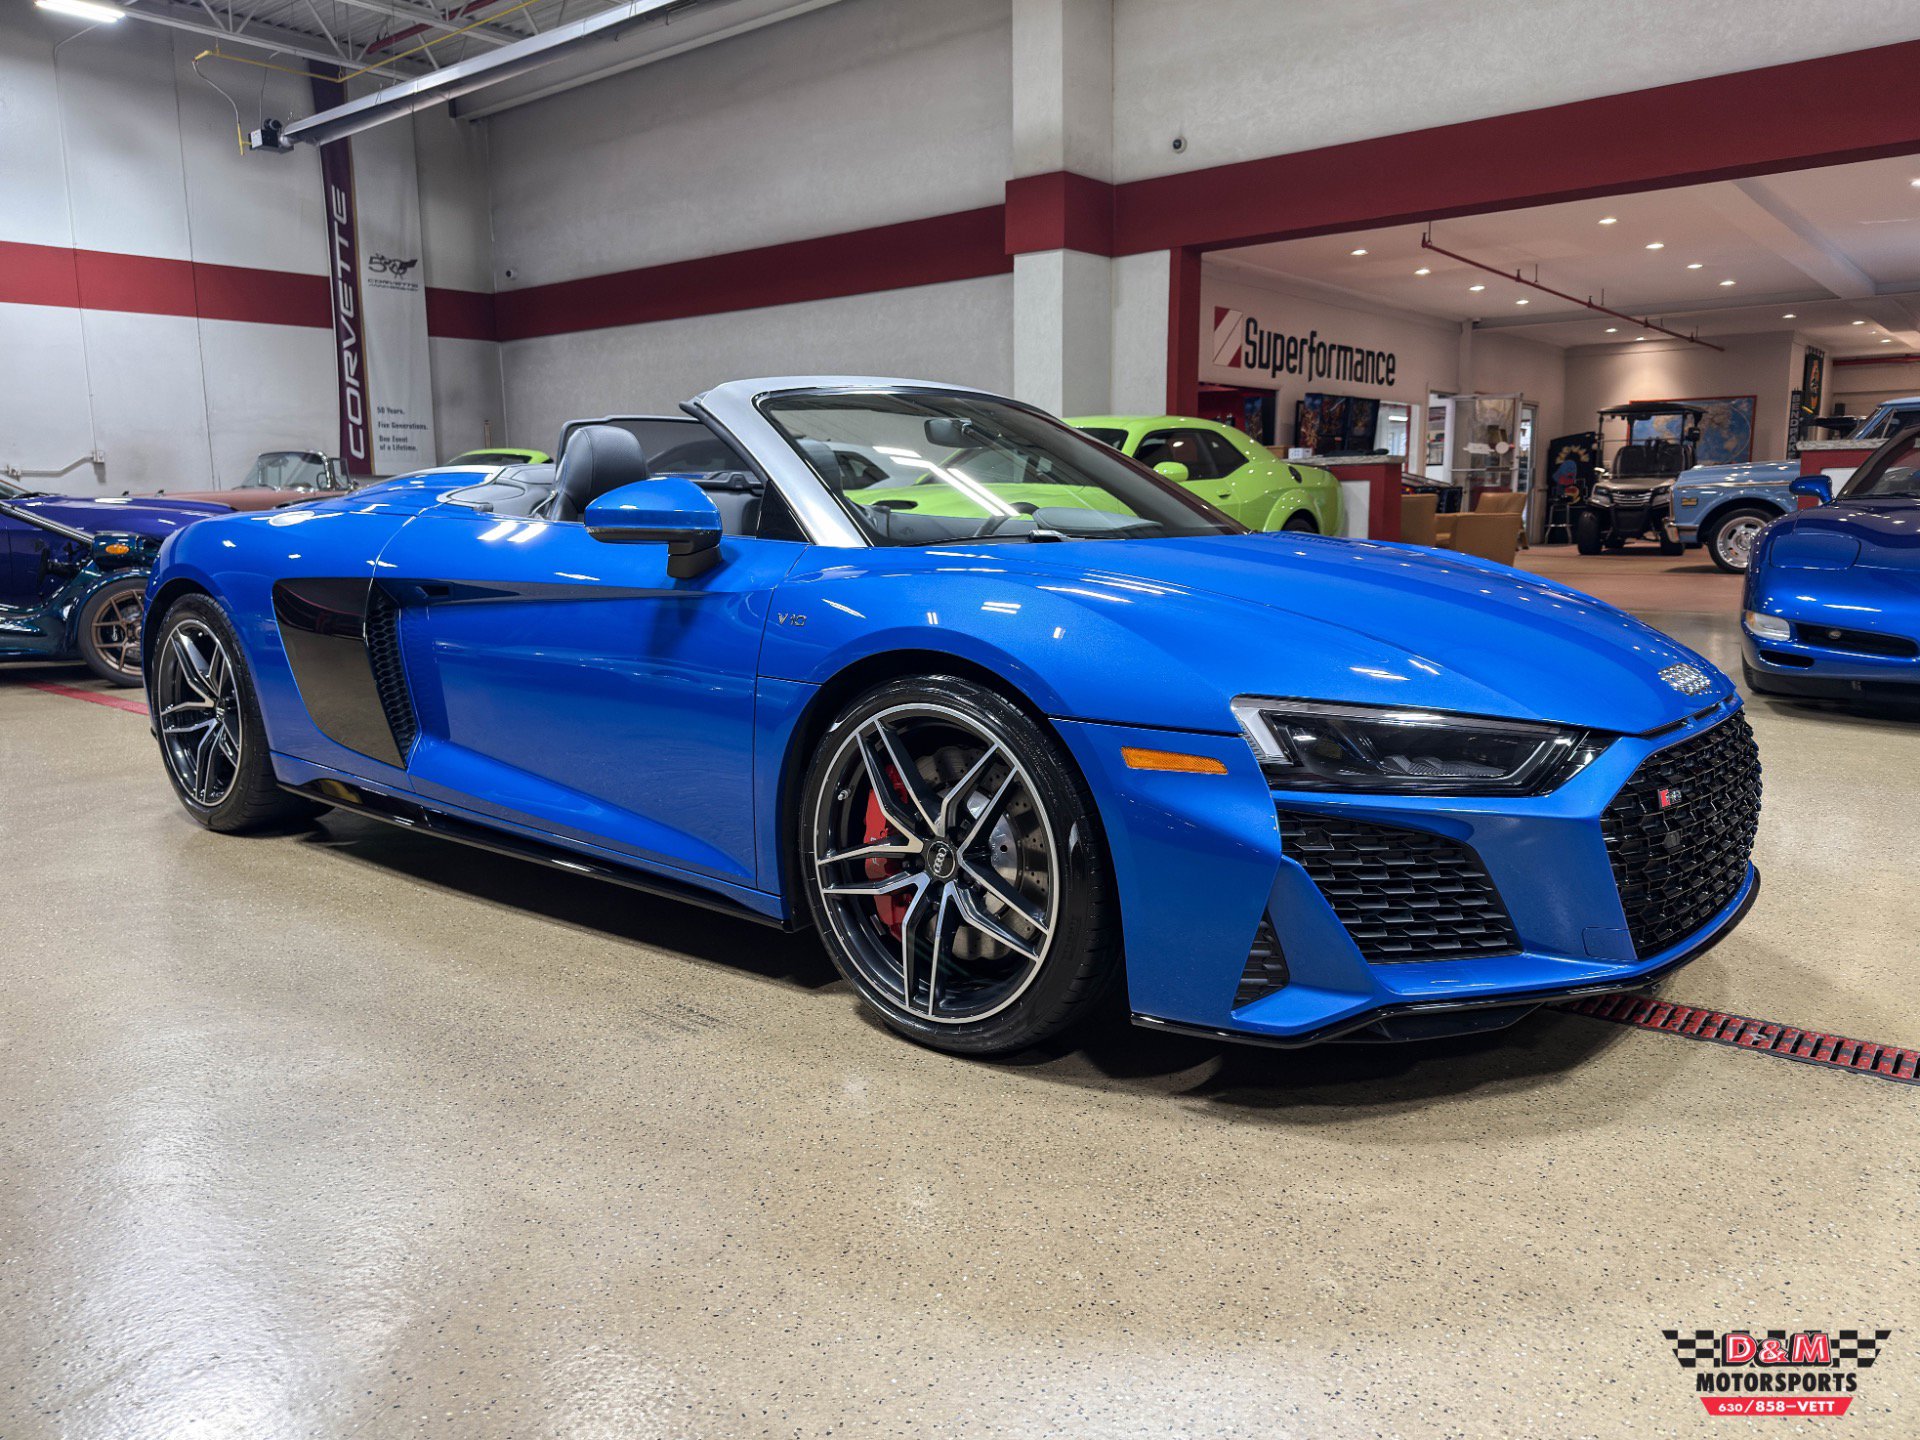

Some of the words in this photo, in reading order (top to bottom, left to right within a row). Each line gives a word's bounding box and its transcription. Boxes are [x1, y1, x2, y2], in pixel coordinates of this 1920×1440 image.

[331, 184, 365, 460] CORVETTE
[1244, 317, 1396, 386] Superformance
[778, 612, 807, 626] V10
